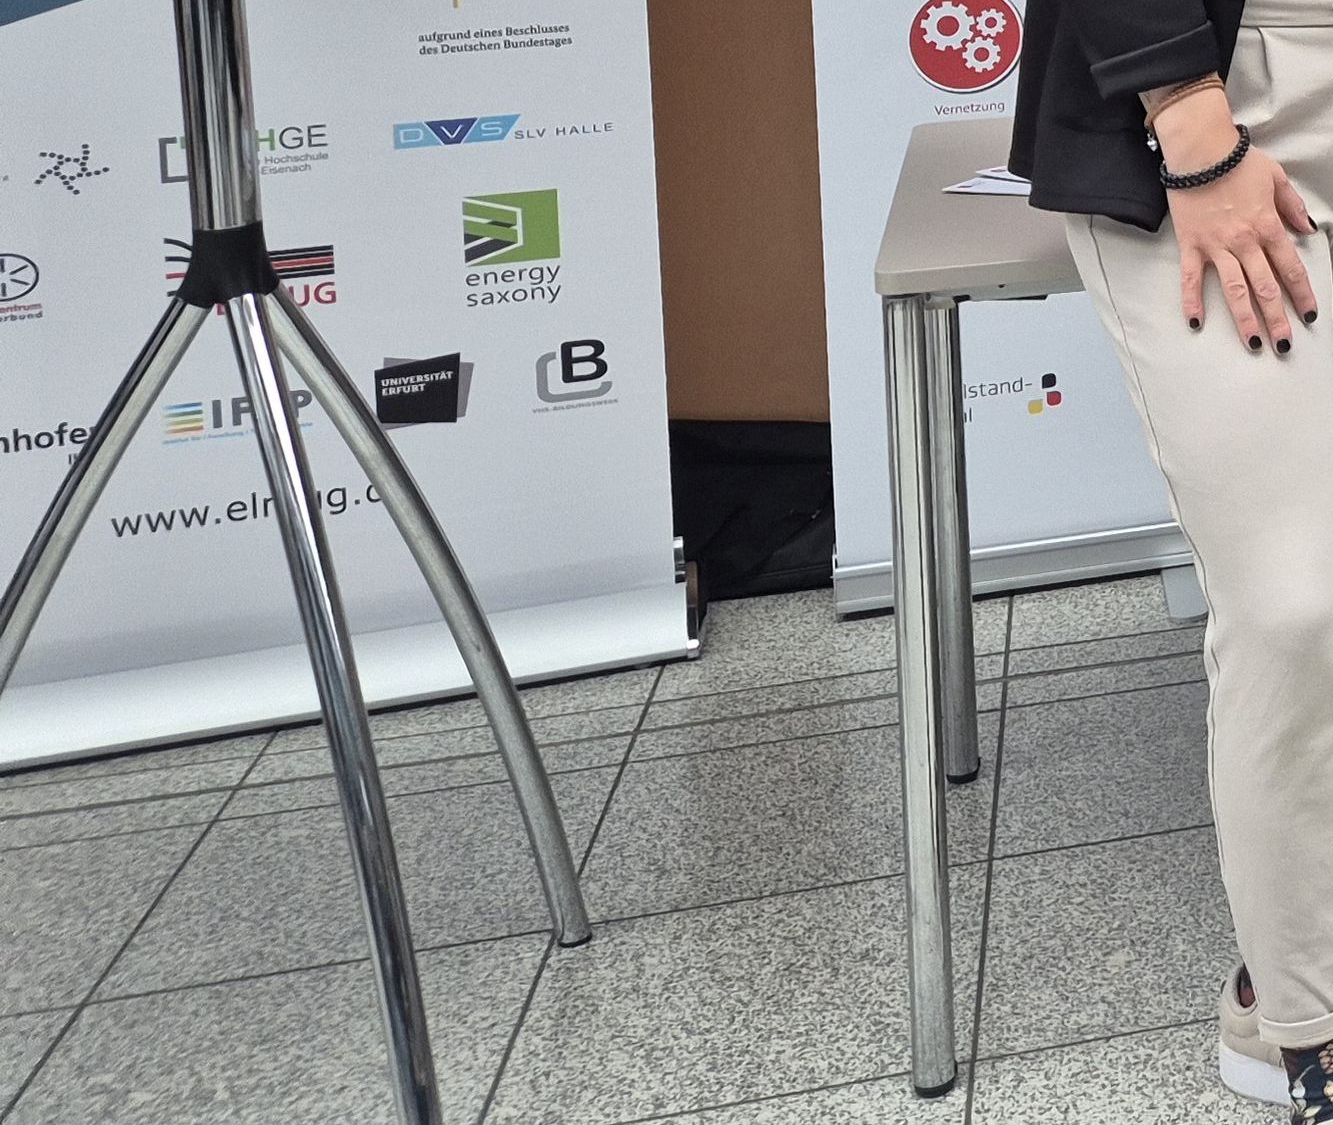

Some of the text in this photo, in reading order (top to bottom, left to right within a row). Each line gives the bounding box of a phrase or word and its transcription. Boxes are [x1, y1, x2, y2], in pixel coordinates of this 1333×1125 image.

[418, 23, 570, 44] aufgrund eines Beschlusses
[419, 36, 573, 56] des Deutschen Bundestages
[934, 101, 1006, 117] Vernetzung
[399, 121, 614, 144] DVS SLV HALLE
[264, 152, 329, 165] Hochschule
[465, 264, 561, 286] energy
[466, 284, 562, 307] saxony
[380, 370, 454, 388] UNIVERSITÄT
[381, 382, 427, 397] ERFURT
